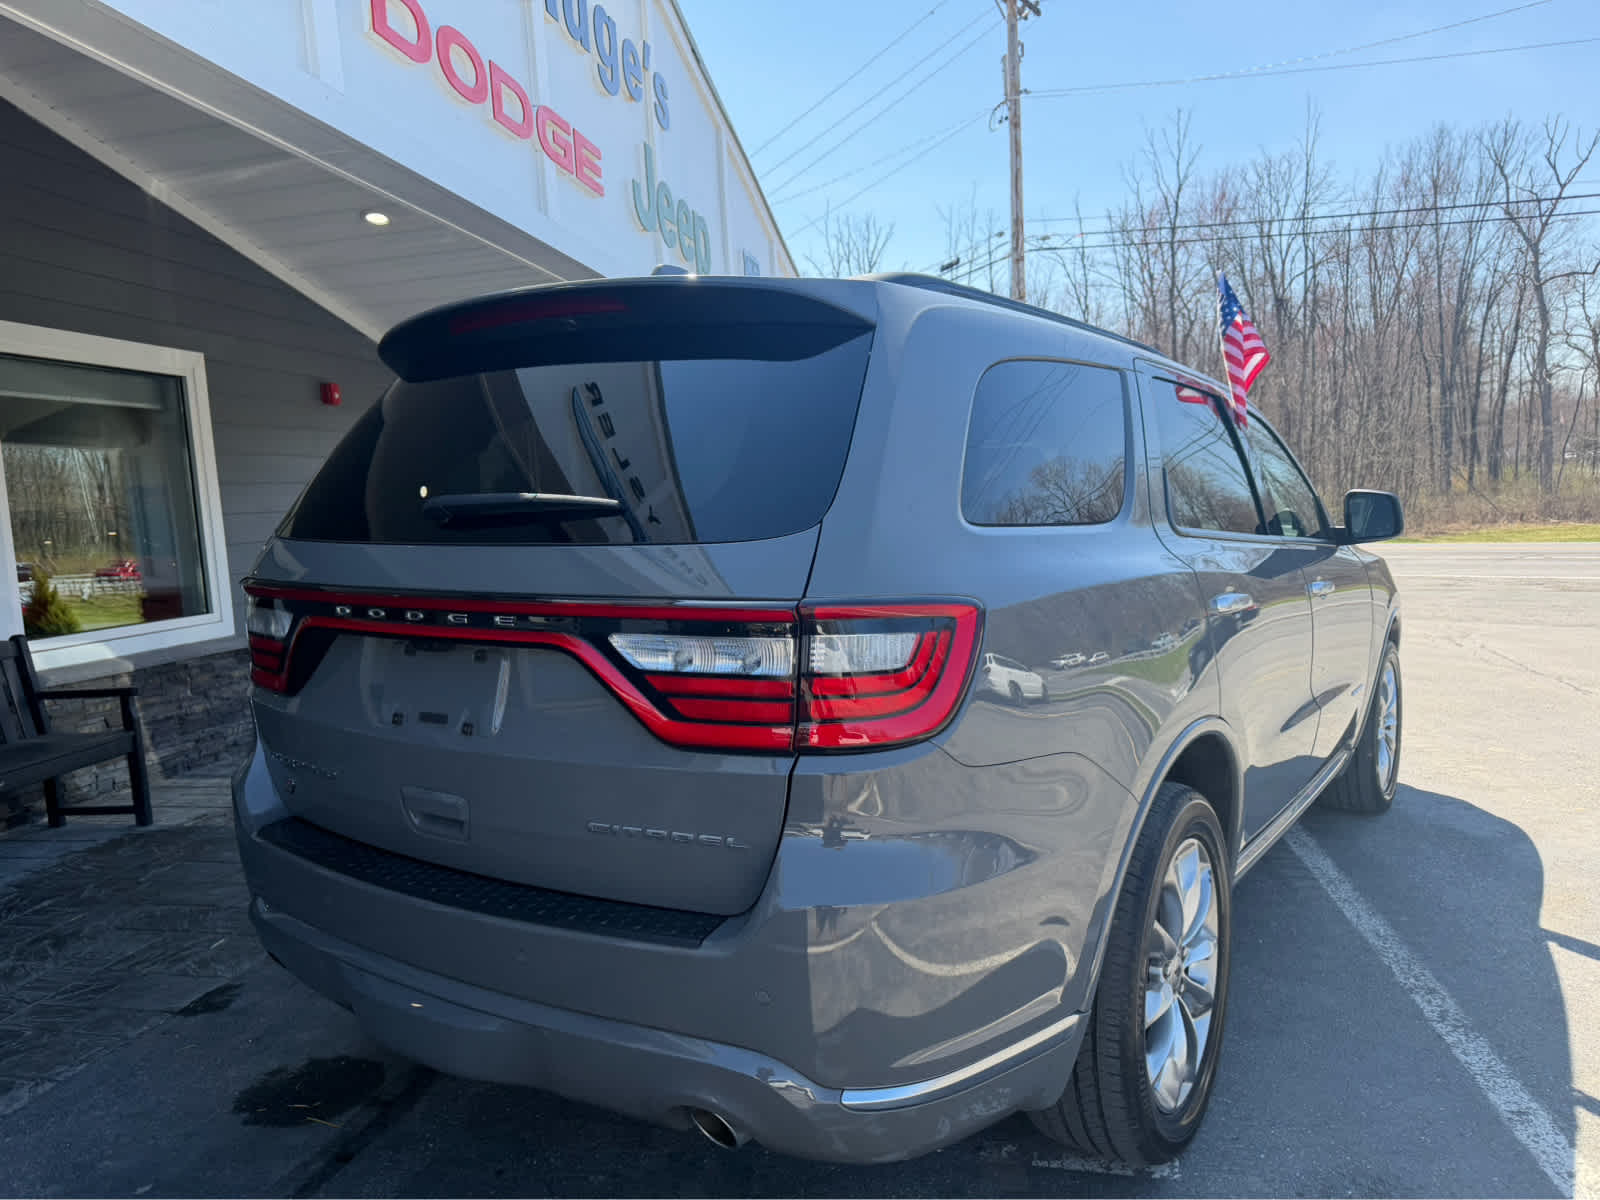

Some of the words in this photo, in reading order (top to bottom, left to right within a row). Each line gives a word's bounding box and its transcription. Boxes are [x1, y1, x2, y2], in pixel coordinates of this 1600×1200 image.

[370, 0, 605, 197] DODGE
[631, 142, 712, 275] Jeep
[335, 604, 516, 627] DODGE
